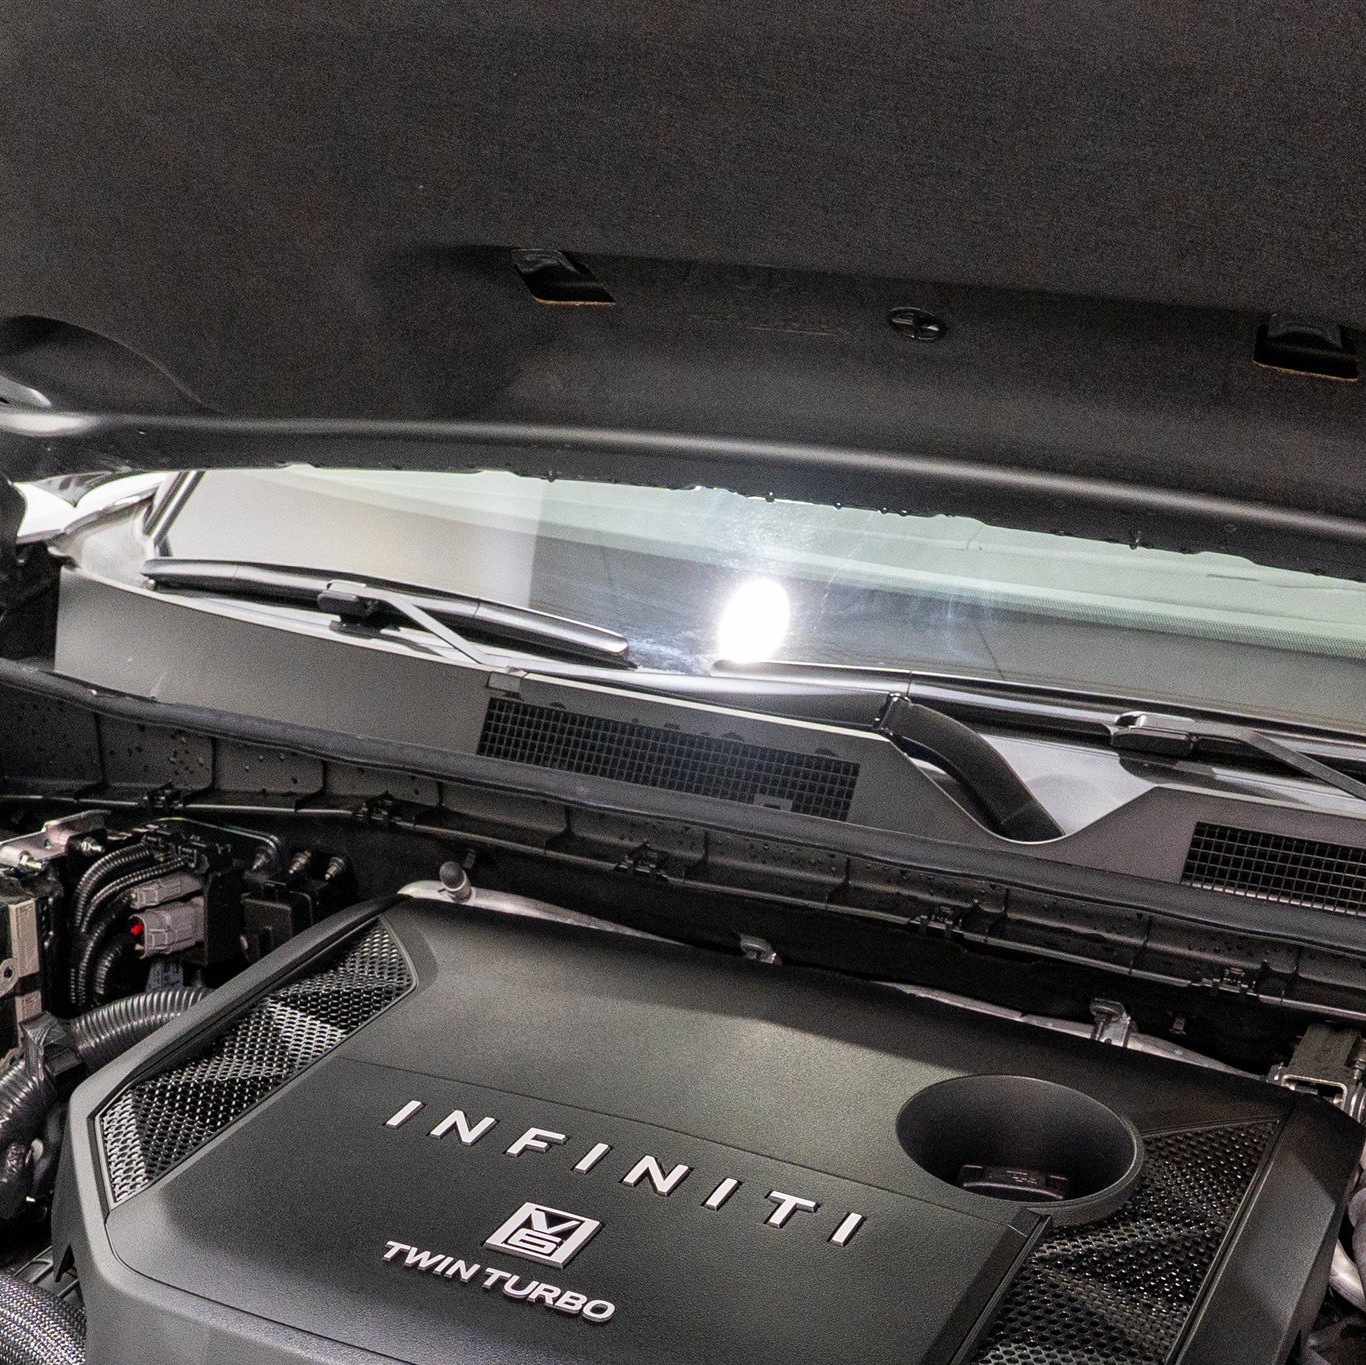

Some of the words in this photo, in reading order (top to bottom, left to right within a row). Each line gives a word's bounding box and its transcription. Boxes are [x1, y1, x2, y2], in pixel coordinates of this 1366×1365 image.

[382, 1099, 866, 1248] INFINITI
[381, 1240, 481, 1284] TWIN
[481, 1267, 617, 1324] TURBO
